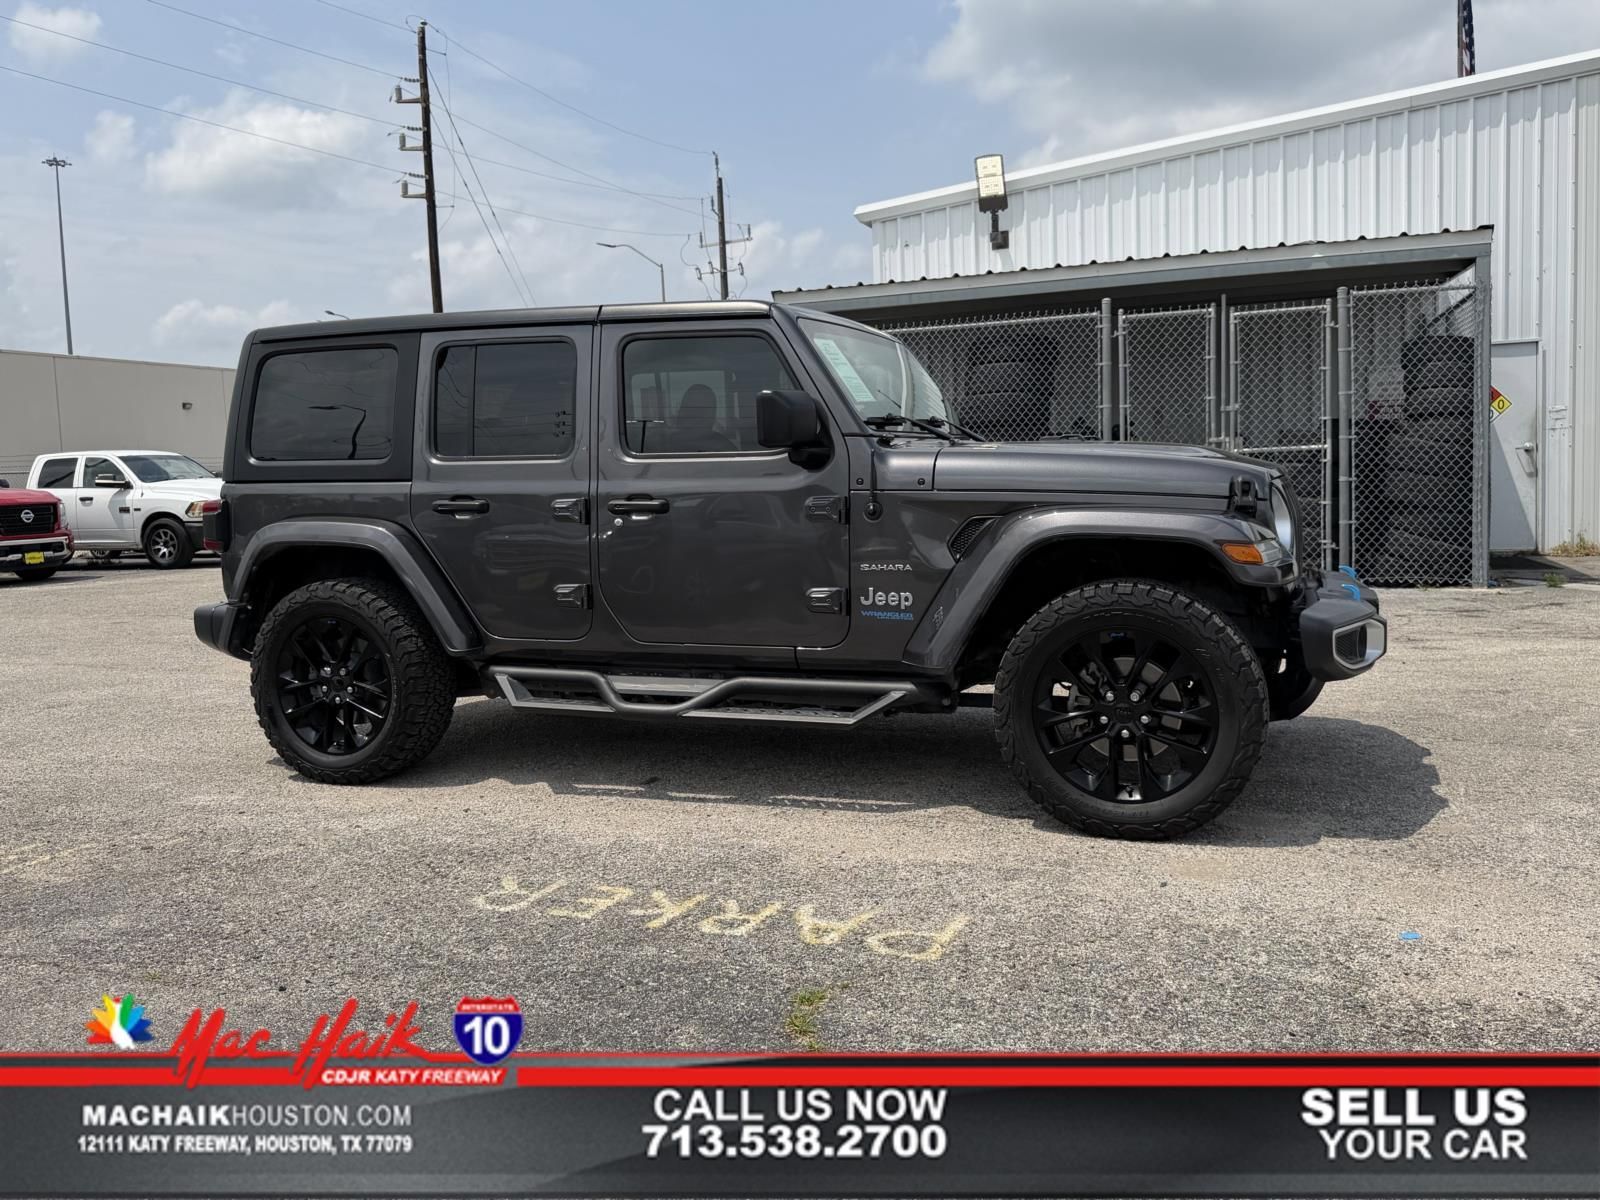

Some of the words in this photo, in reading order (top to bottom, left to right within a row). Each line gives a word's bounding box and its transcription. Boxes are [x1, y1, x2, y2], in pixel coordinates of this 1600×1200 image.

[1497, 399, 1505, 409] 0
[860, 587, 913, 610] Jeep
[473, 875, 970, 961] PARKER
